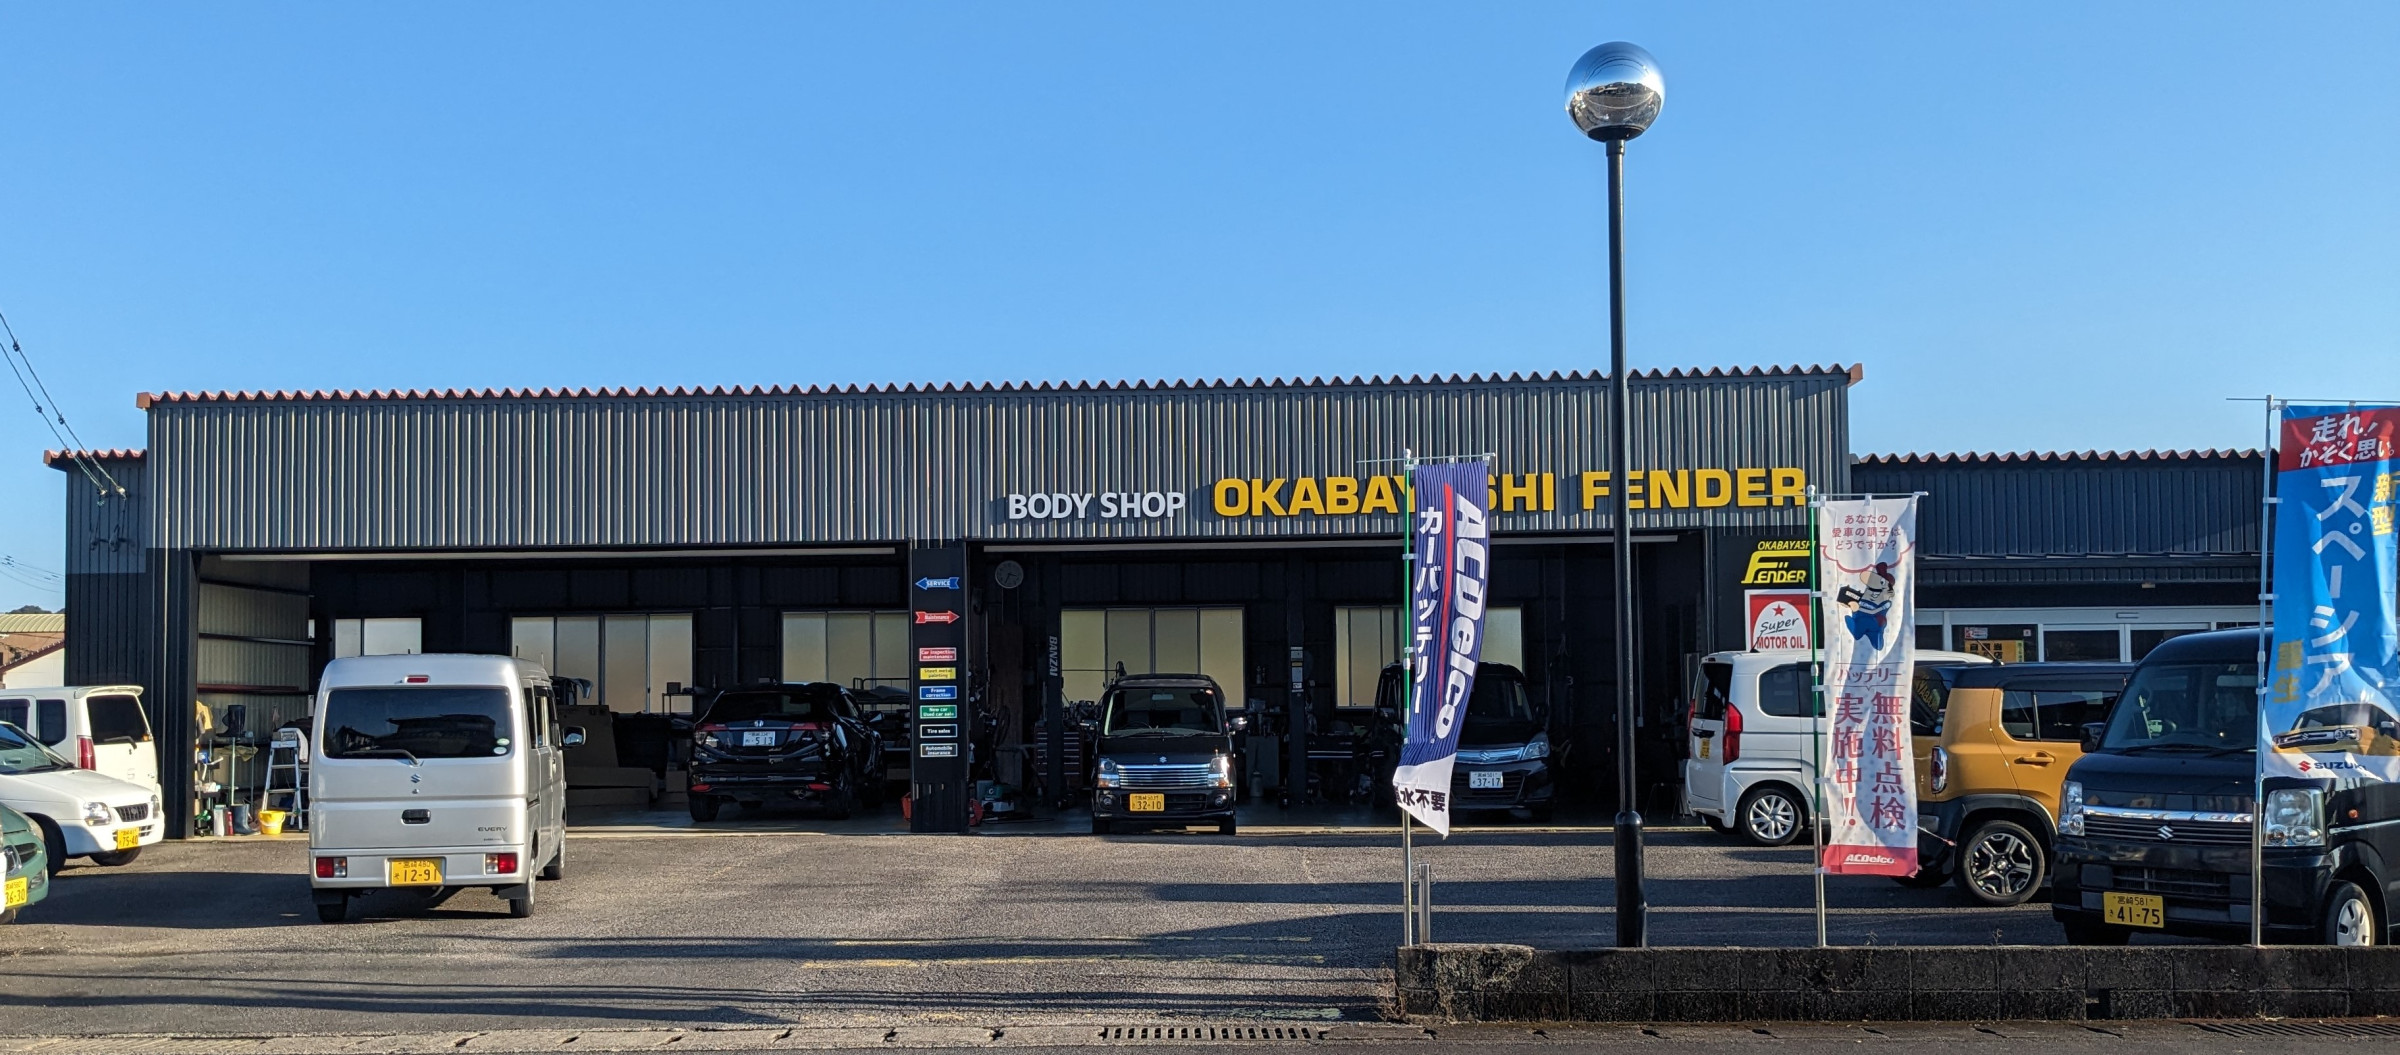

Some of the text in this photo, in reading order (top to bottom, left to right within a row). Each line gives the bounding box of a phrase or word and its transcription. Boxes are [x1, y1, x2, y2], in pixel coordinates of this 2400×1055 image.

[1214, 467, 1806, 517] OKABAHI FENDER
[1008, 491, 1186, 520] BODY SHOP
[1844, 514, 1888, 524] あなたの
[1832, 527, 1901, 538] 愛車の調子は
[1757, 540, 1817, 551] OKABAYAS
[1741, 550, 1811, 584] FENDER
[926, 579, 950, 587] SERVICE
[2307, 475, 2366, 698] スペーシア
[1415, 506, 1442, 714] カーバッテリー
[1435, 493, 1486, 739] ACDelco
[1761, 617, 1800, 633] Super
[1757, 636, 1805, 649] MOTOR OIL
[1049, 635, 1058, 677] BANZAI
[1870, 691, 1906, 830] 無料点検
[1477, 777, 1500, 787] 37-17
[1137, 800, 1162, 810] 32-10
[1844, 853, 1895, 864] ACDelco
[404, 869, 437, 882] 12-91
[2117, 906, 2160, 925] 41-75
